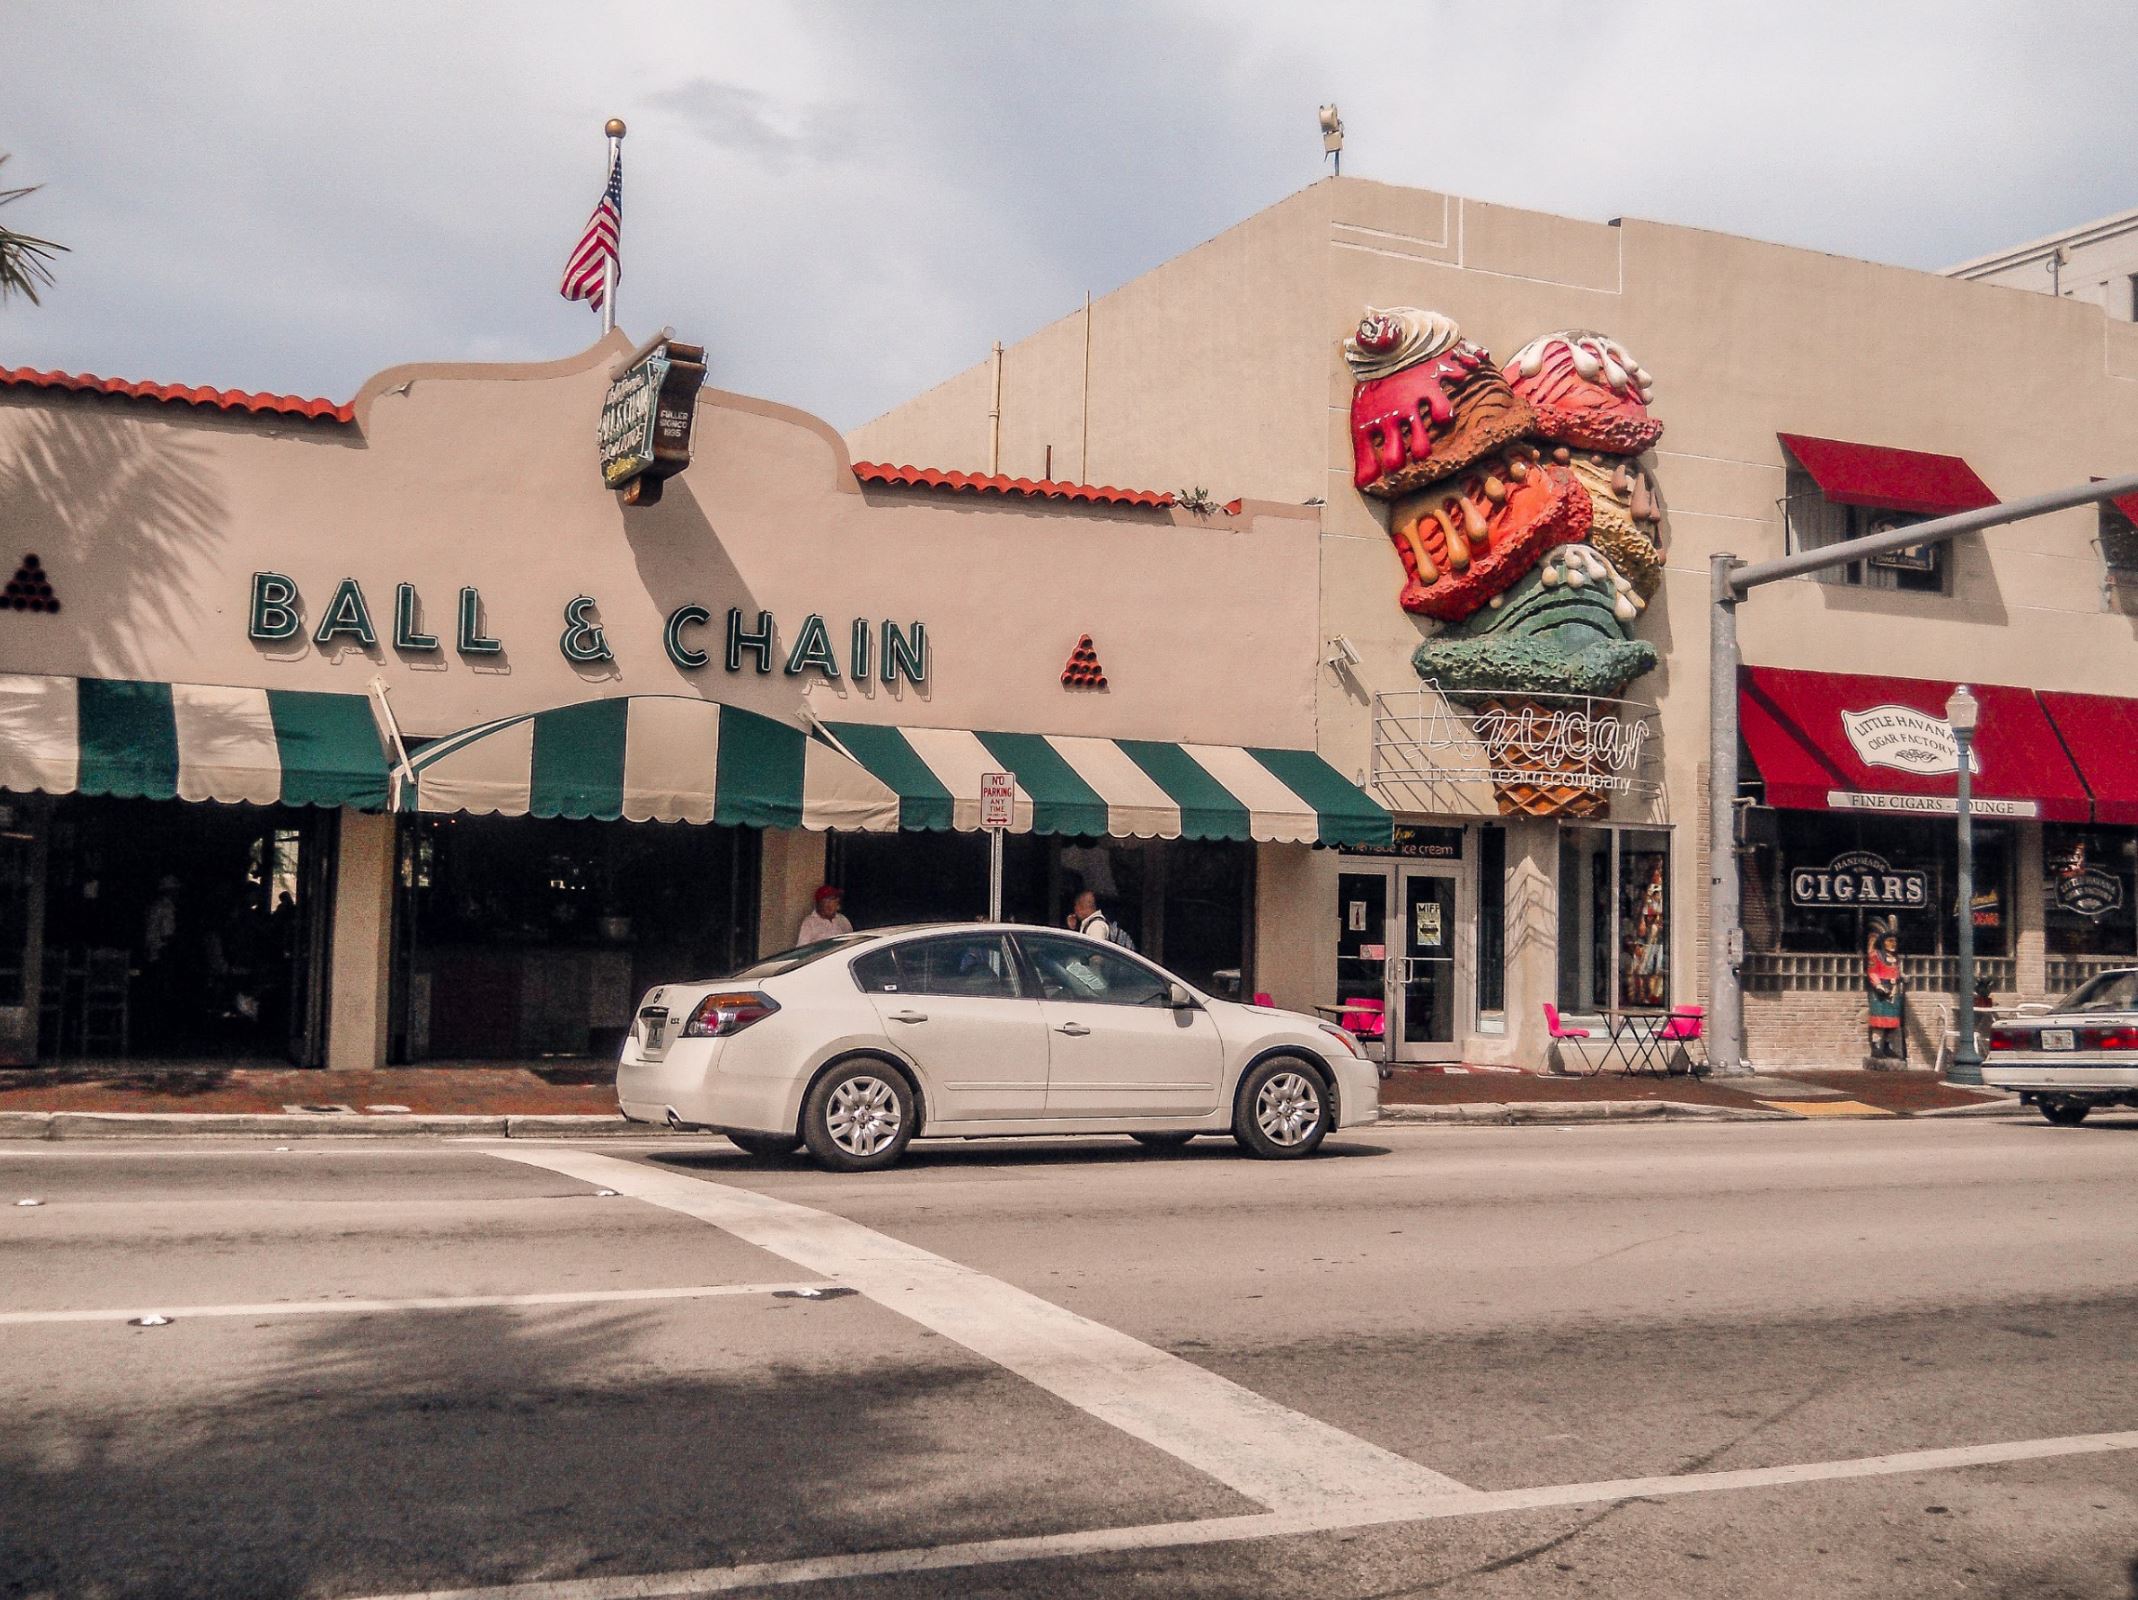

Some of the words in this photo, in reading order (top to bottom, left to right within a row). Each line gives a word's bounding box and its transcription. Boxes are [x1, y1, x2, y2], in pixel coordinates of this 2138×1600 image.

[249, 571, 501, 655] BALL
[559, 594, 615, 663] &
[662, 602, 928, 683] CHAIN
[1854, 716, 1895, 737] LITTLE
[1899, 716, 1957, 744] HAVANA
[1868, 733, 1899, 751] CIGAR
[1900, 733, 1956, 756] FACTORY
[991, 775, 1005, 785] NO
[1551, 772, 1631, 796] company
[983, 787, 1012, 797] PARKING
[1852, 794, 1886, 807] FINE
[1889, 796, 1943, 810] CIGARS
[1401, 842, 1417, 855] ice
[1418, 844, 1454, 855] cream
[1795, 873, 1923, 903] CIGARS
